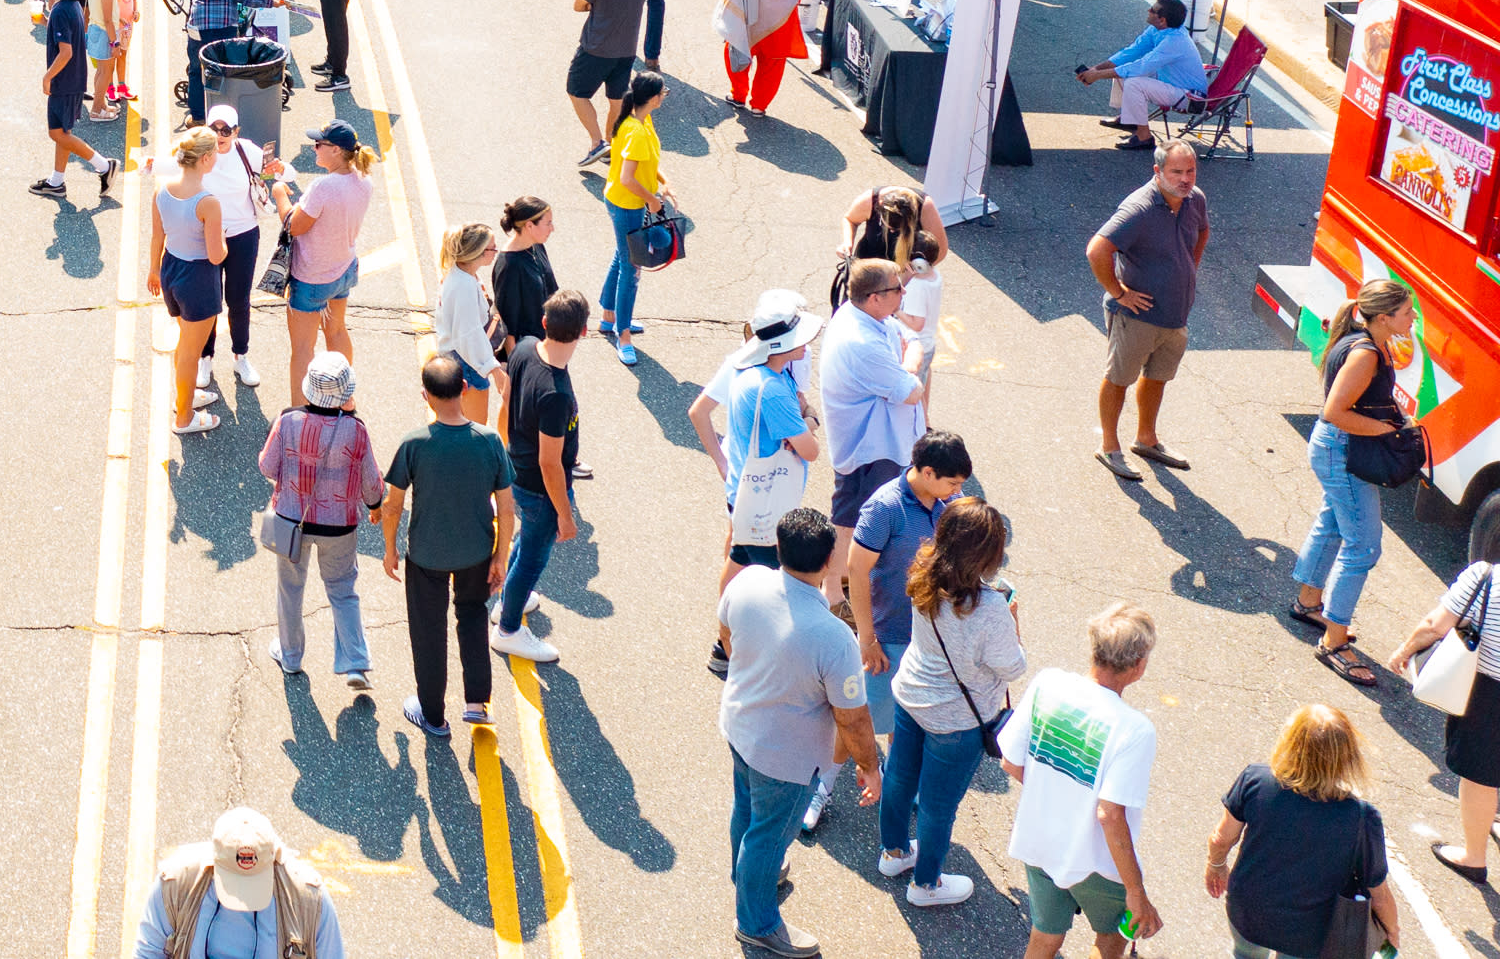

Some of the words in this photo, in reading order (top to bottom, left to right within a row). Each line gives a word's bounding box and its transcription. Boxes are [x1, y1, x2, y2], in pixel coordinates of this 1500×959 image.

[1360, 76, 1381, 100] SAUS
[1401, 47, 1447, 83] First
[1450, 62, 1493, 100] Class
[1355, 88, 1363, 101] &
[1363, 91, 1380, 113] PEP
[1410, 75, 1500, 131] Concessions
[1395, 100, 1492, 169] CATERING
[1395, 165, 1453, 218] CANNOLI'S
[742, 474, 767, 483] STOC
[843, 675, 860, 701] 6
